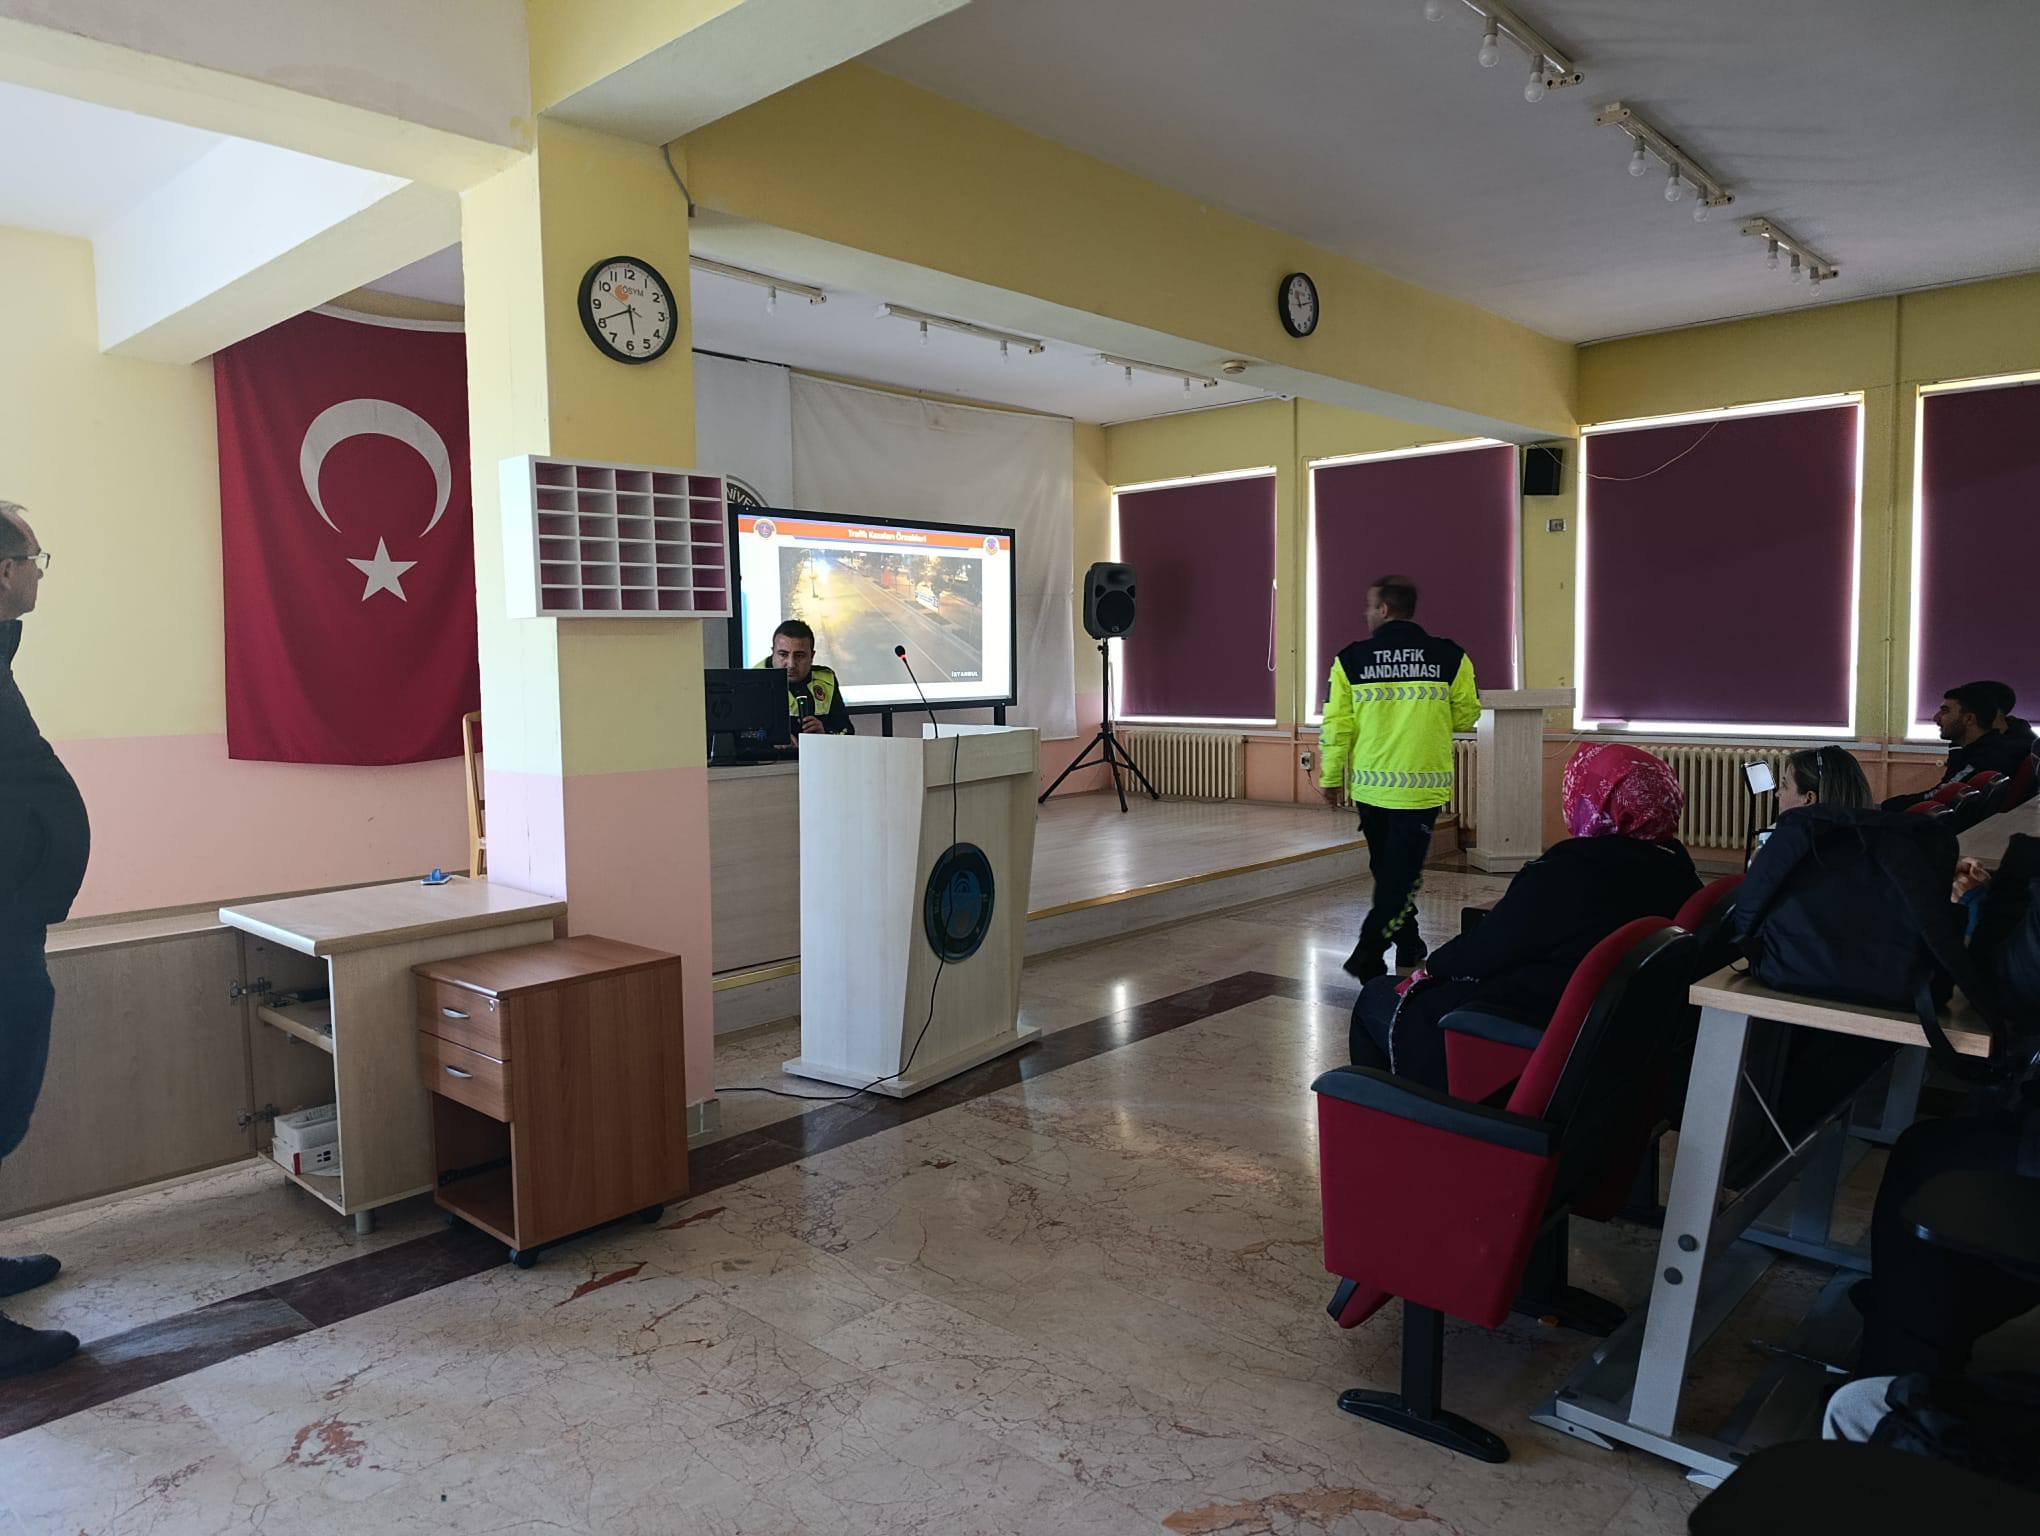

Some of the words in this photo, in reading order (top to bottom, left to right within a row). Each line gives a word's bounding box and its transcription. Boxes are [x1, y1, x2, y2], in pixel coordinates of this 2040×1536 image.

[610, 270, 618, 282] 11
[624, 268, 636, 281] 12
[599, 280, 611, 292] 10
[651, 292, 660, 303] 2
[592, 298, 602, 310] 9
[657, 311, 665, 322] 3
[598, 317, 607, 329] 8
[609, 331, 618, 343] 7
[653, 328, 661, 339] 4
[626, 340, 635, 351] 6
[642, 338, 651, 350] 5
[1360, 664, 1440, 680] JANDARMASI
